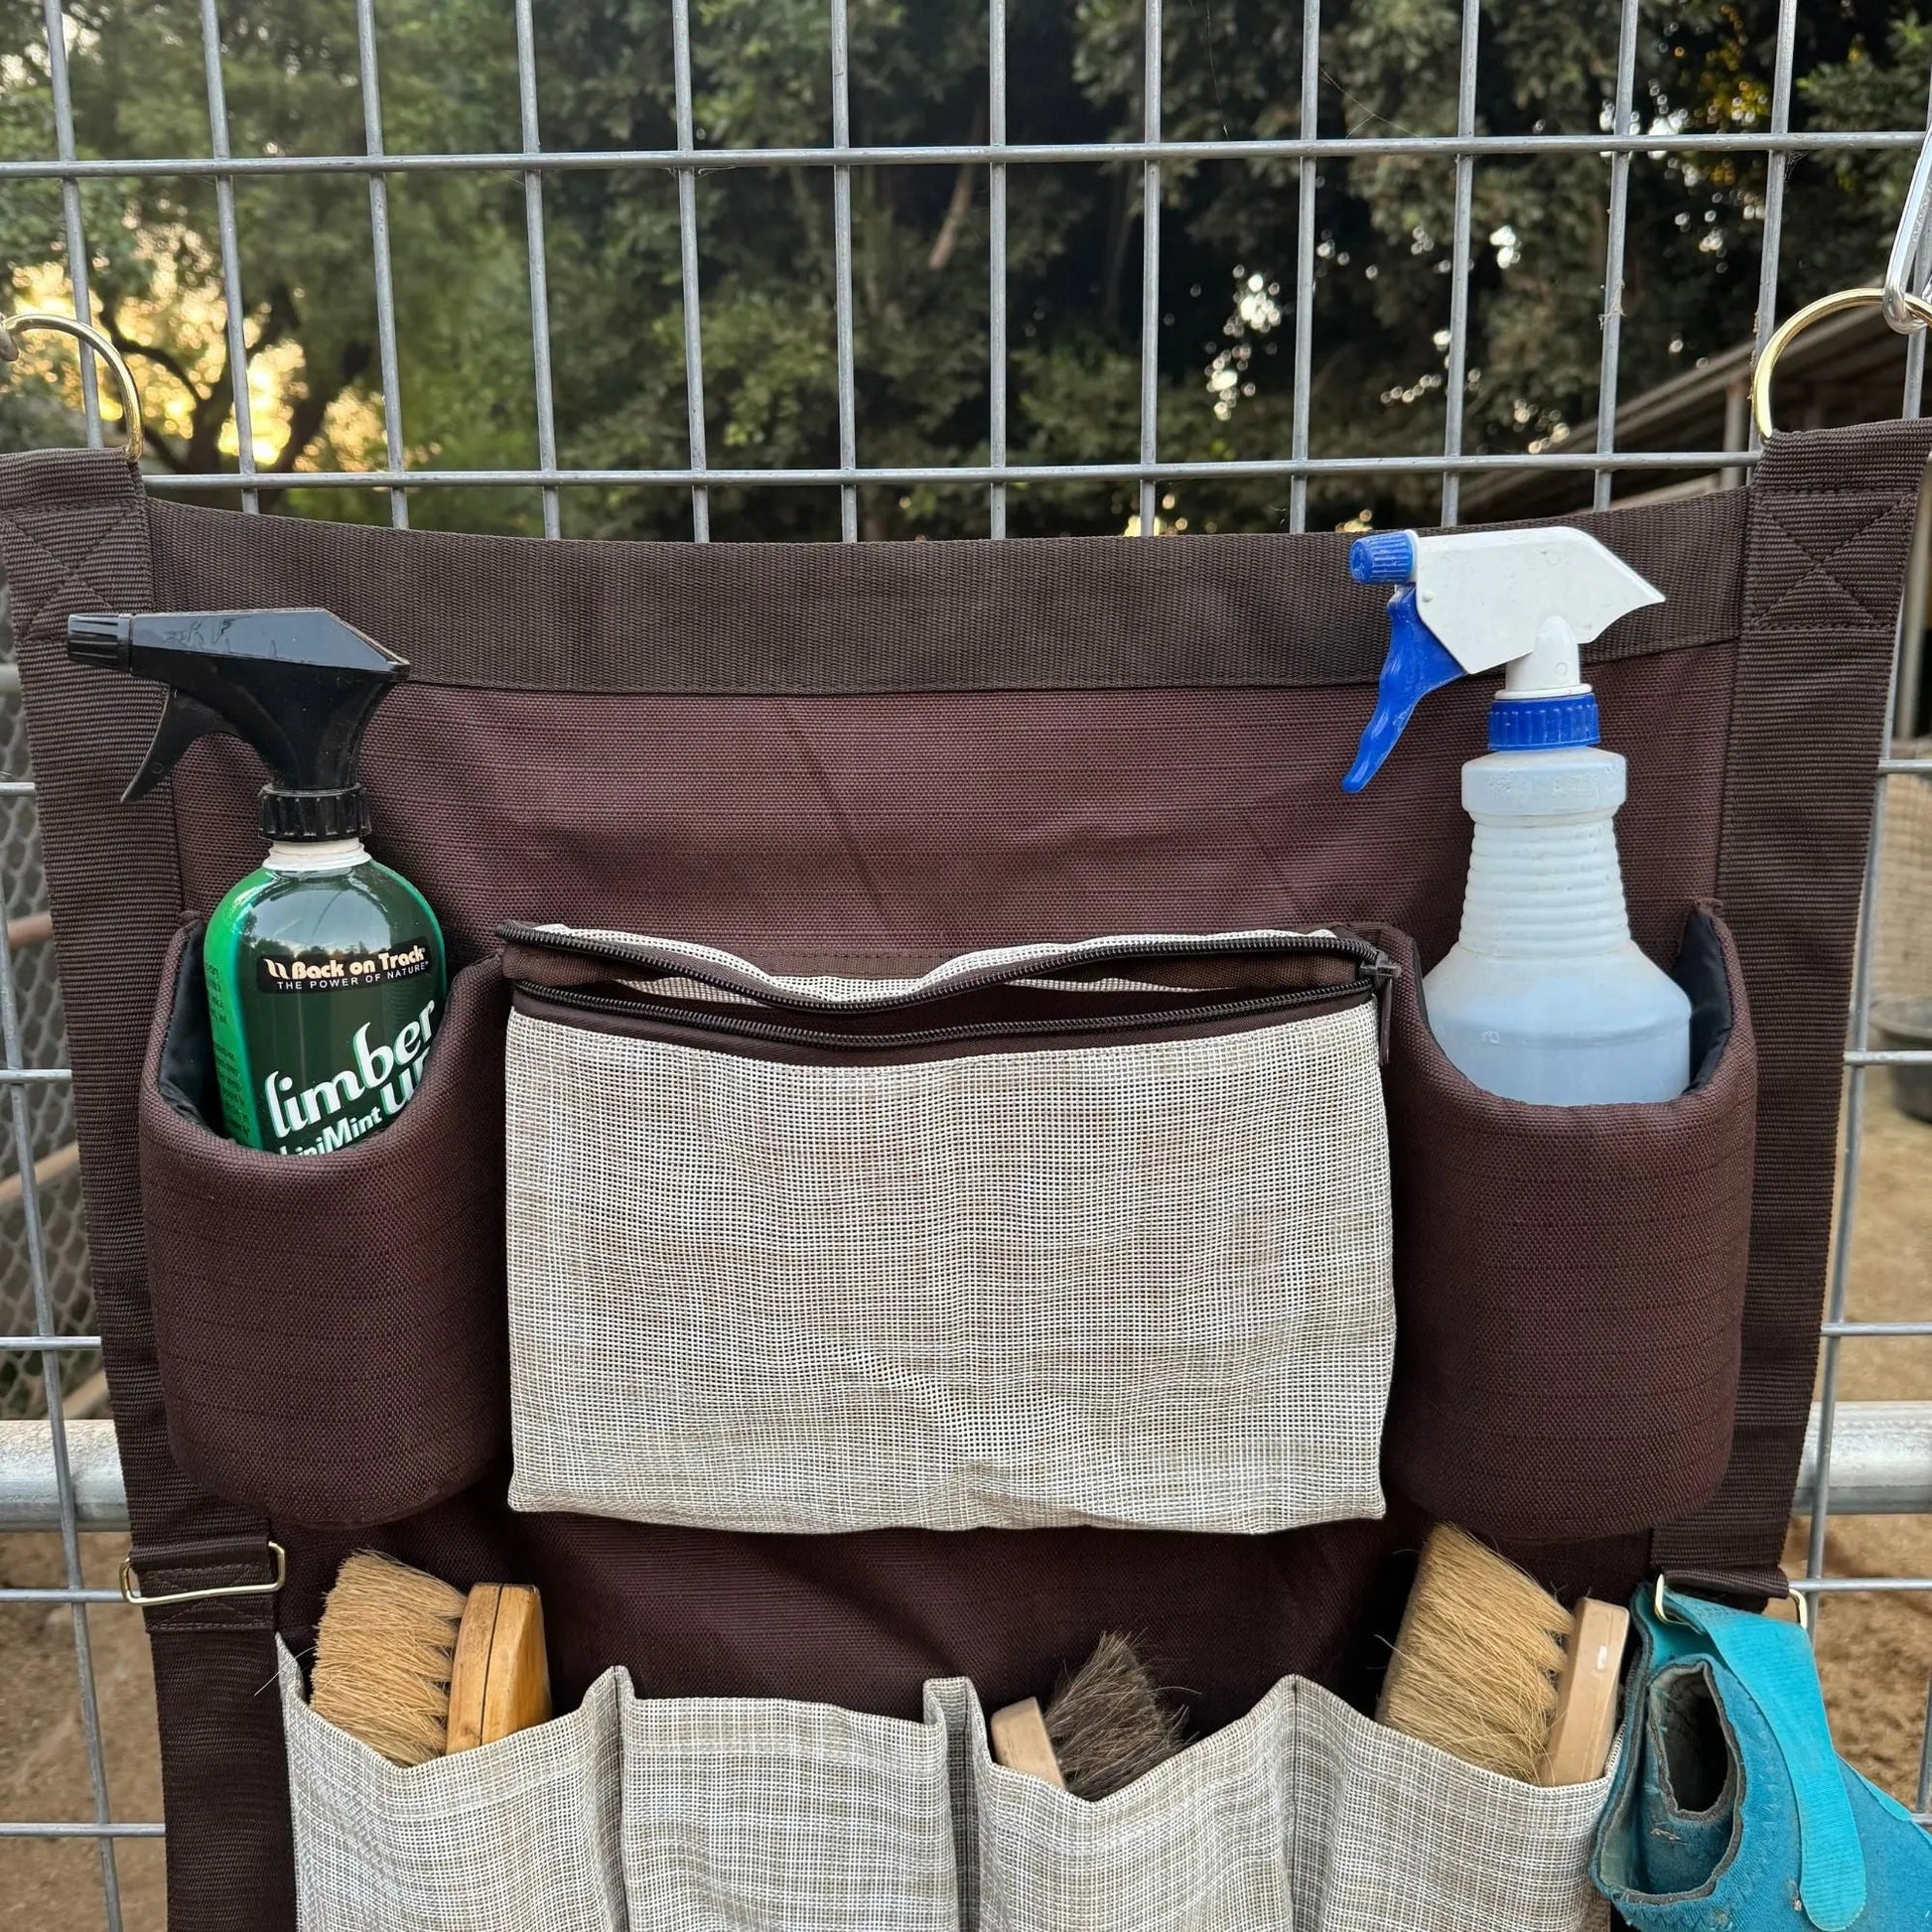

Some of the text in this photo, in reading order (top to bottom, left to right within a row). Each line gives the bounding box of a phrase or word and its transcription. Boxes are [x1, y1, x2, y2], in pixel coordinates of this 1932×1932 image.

[292, 959, 345, 979] Back
[349, 960, 376, 975] on
[277, 981, 302, 990] THE
[310, 978, 358, 989] POWER
[366, 974, 381, 983] OF
[264, 999, 435, 1139] limber
